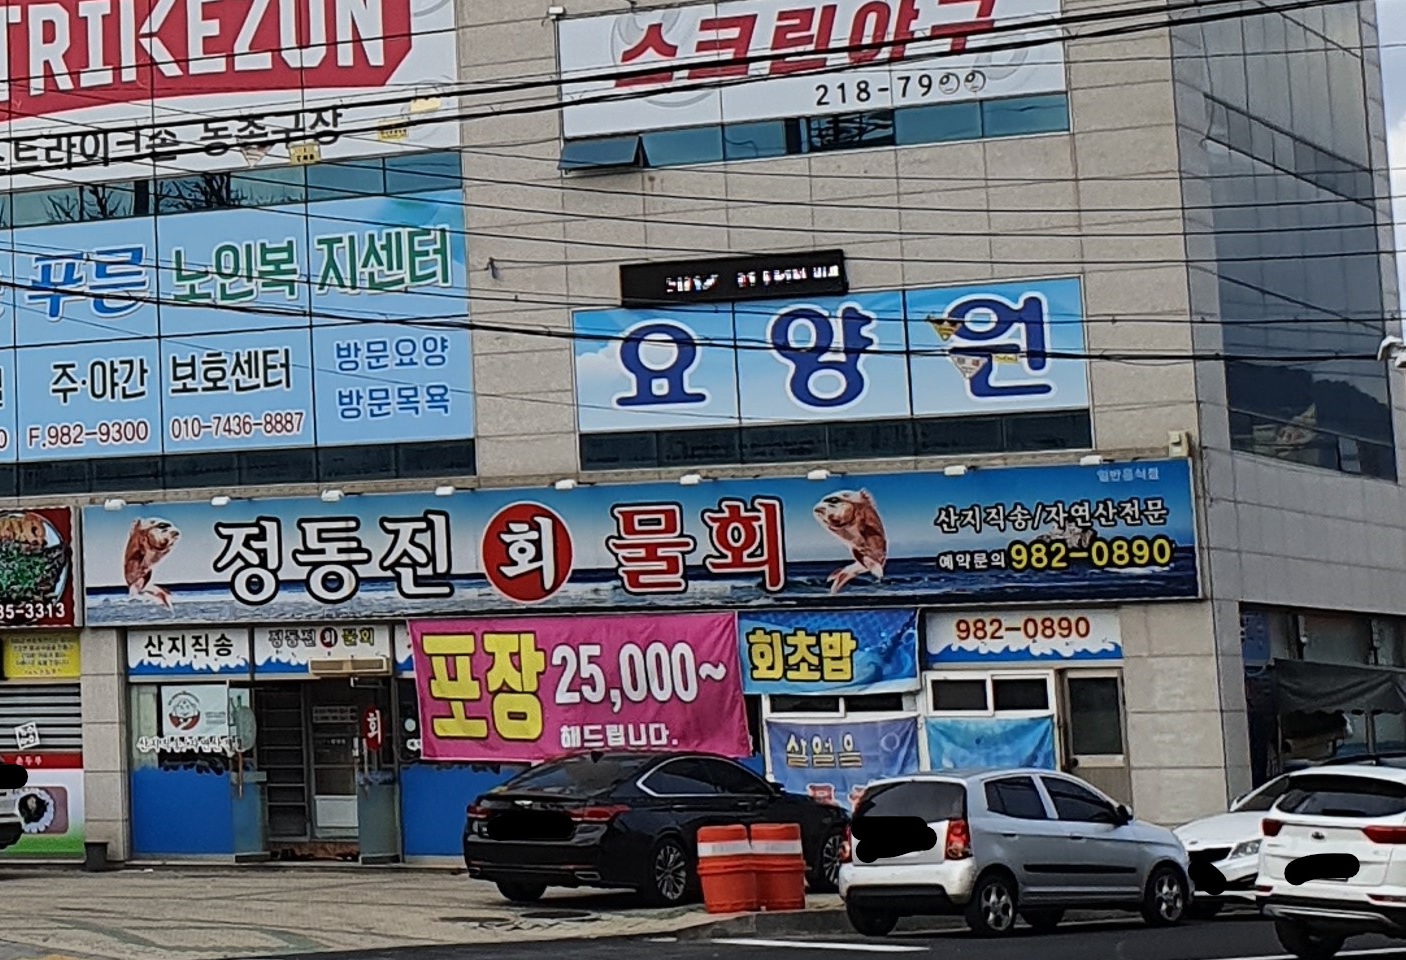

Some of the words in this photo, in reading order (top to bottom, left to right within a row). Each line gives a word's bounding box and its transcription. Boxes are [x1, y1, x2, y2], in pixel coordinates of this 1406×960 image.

[815, 70, 987, 107] 218-7900
[170, 346, 292, 394] 보호센터
[334, 335, 450, 372] 방문요양
[337, 384, 451, 419] 방문목욕
[27, 420, 149, 448] F.982-9300
[171, 411, 305, 440] 010-7436-8887
[213, 509, 454, 605] 정동진
[500, 516, 555, 592] 회
[606, 496, 786, 595] 물회
[937, 550, 1006, 571] 예약문의
[1008, 537, 1174, 570] 982-0890
[144, 632, 234, 658] 산지직송
[954, 615, 1091, 642] 982-0890
[746, 626, 857, 683] 회초밥
[421, 631, 546, 740] 포장
[559, 722, 679, 749] 해드립니다.
